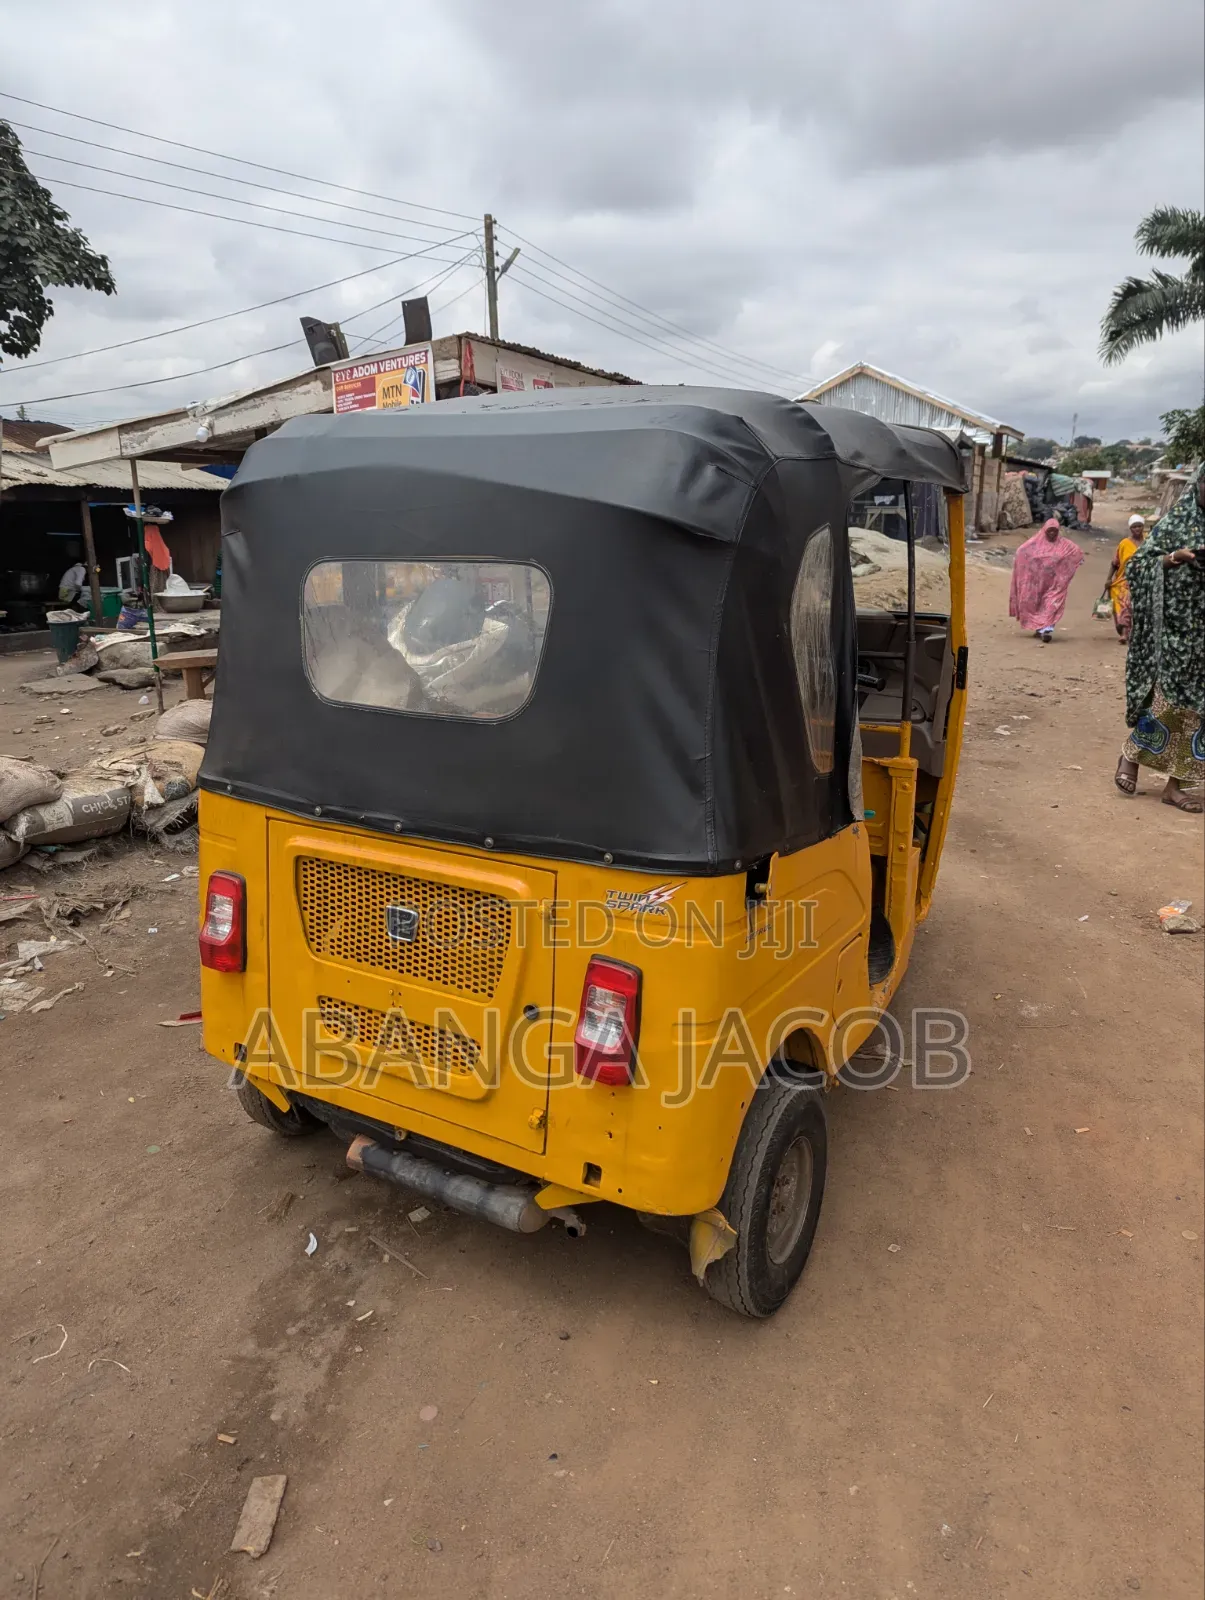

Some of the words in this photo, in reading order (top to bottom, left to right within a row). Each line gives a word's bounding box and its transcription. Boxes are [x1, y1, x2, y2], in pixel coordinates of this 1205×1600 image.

[352, 364, 378, 379] ADOM
[379, 352, 426, 373] VENTURES
[382, 384, 402, 400] MTN
[605, 889, 652, 902] TWIN
[605, 900, 668, 916] SPARK
